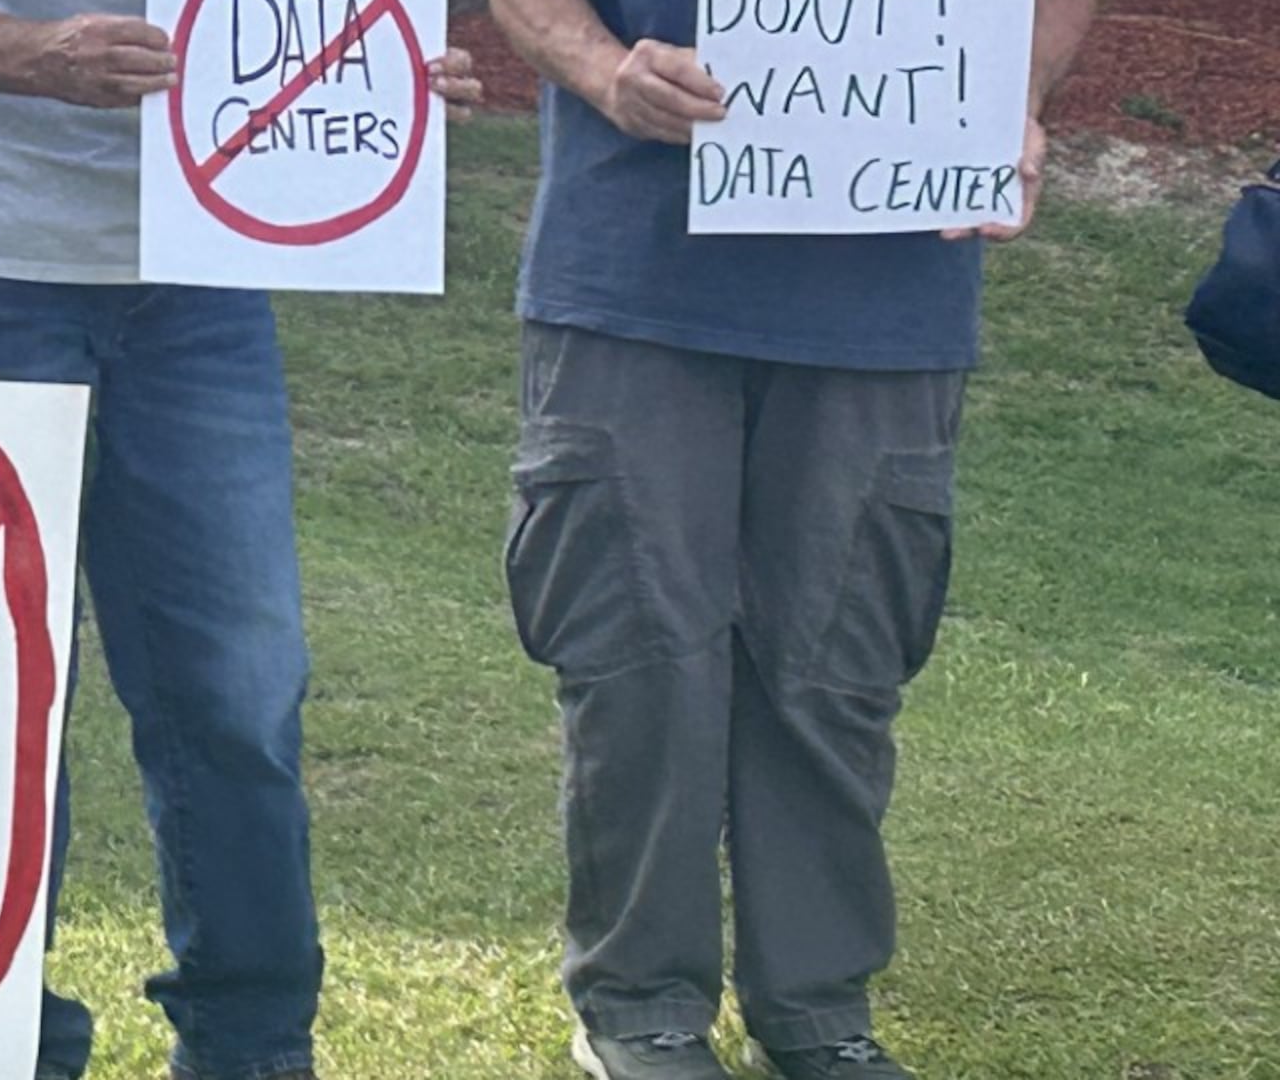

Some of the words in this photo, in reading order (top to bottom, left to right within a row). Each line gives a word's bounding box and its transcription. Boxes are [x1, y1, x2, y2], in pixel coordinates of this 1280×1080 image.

[212, 96, 400, 160] CENTERS
[695, 141, 812, 206] DATA
[849, 158, 1017, 215] CENTER
